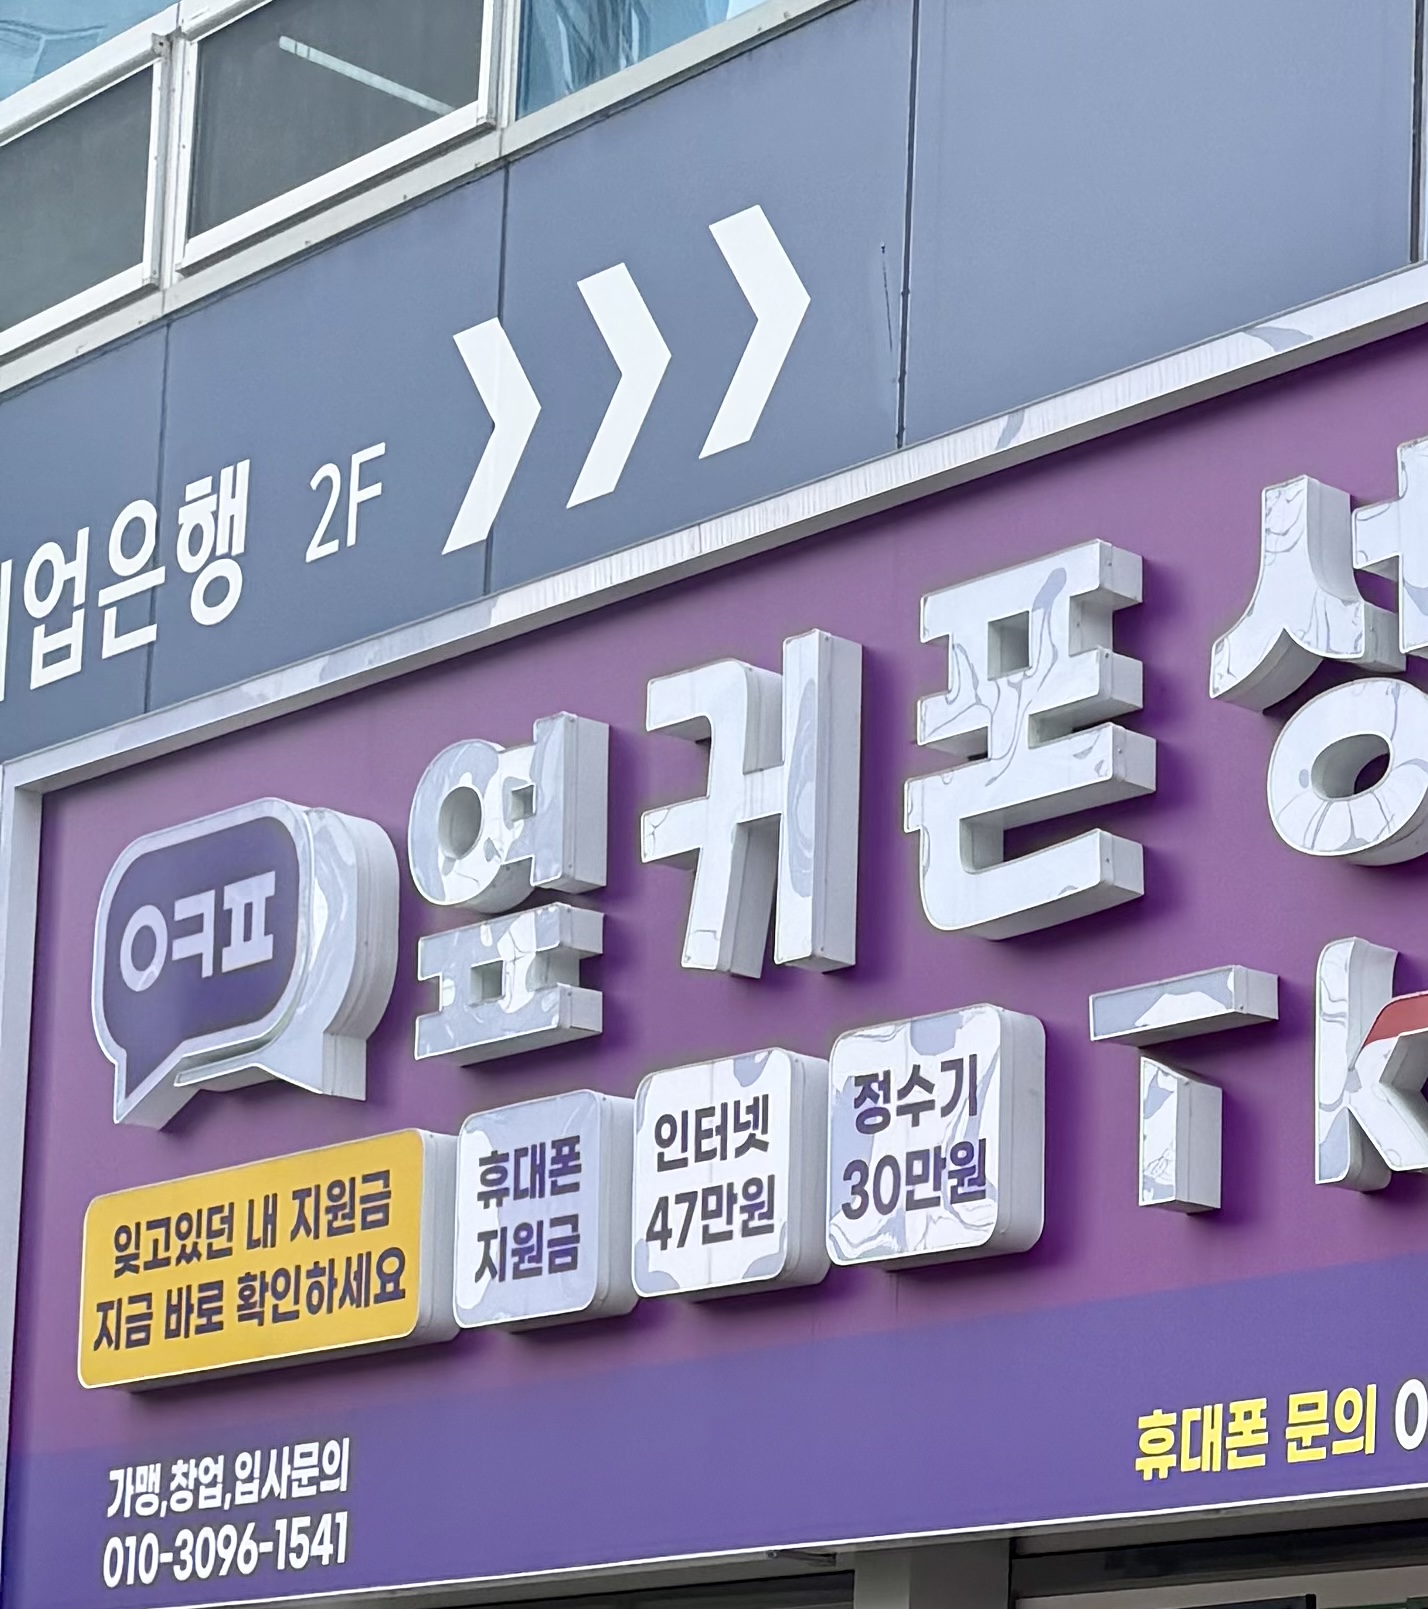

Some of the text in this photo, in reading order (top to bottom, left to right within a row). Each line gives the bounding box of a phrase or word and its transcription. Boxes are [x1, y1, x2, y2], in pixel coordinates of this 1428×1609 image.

[0, 442, 386, 702] 업은행 2F
[654, 1092, 770, 1172] 인터넷
[853, 1053, 979, 1137] 정수기
[477, 1134, 582, 1210] 휴대폰
[645, 1174, 775, 1252] 47만원
[840, 1137, 988, 1222] 30만원
[112, 1170, 391, 1279] 잊고있던 내 지원금
[475, 1213, 581, 1284] 지원금
[93, 1247, 407, 1353] 지금 바로 확인하세요
[1134, 1392, 1268, 1481] 휴대폰
[1285, 1385, 1377, 1463] 문의
[103, 1511, 348, 1588] 010-3096-1541
